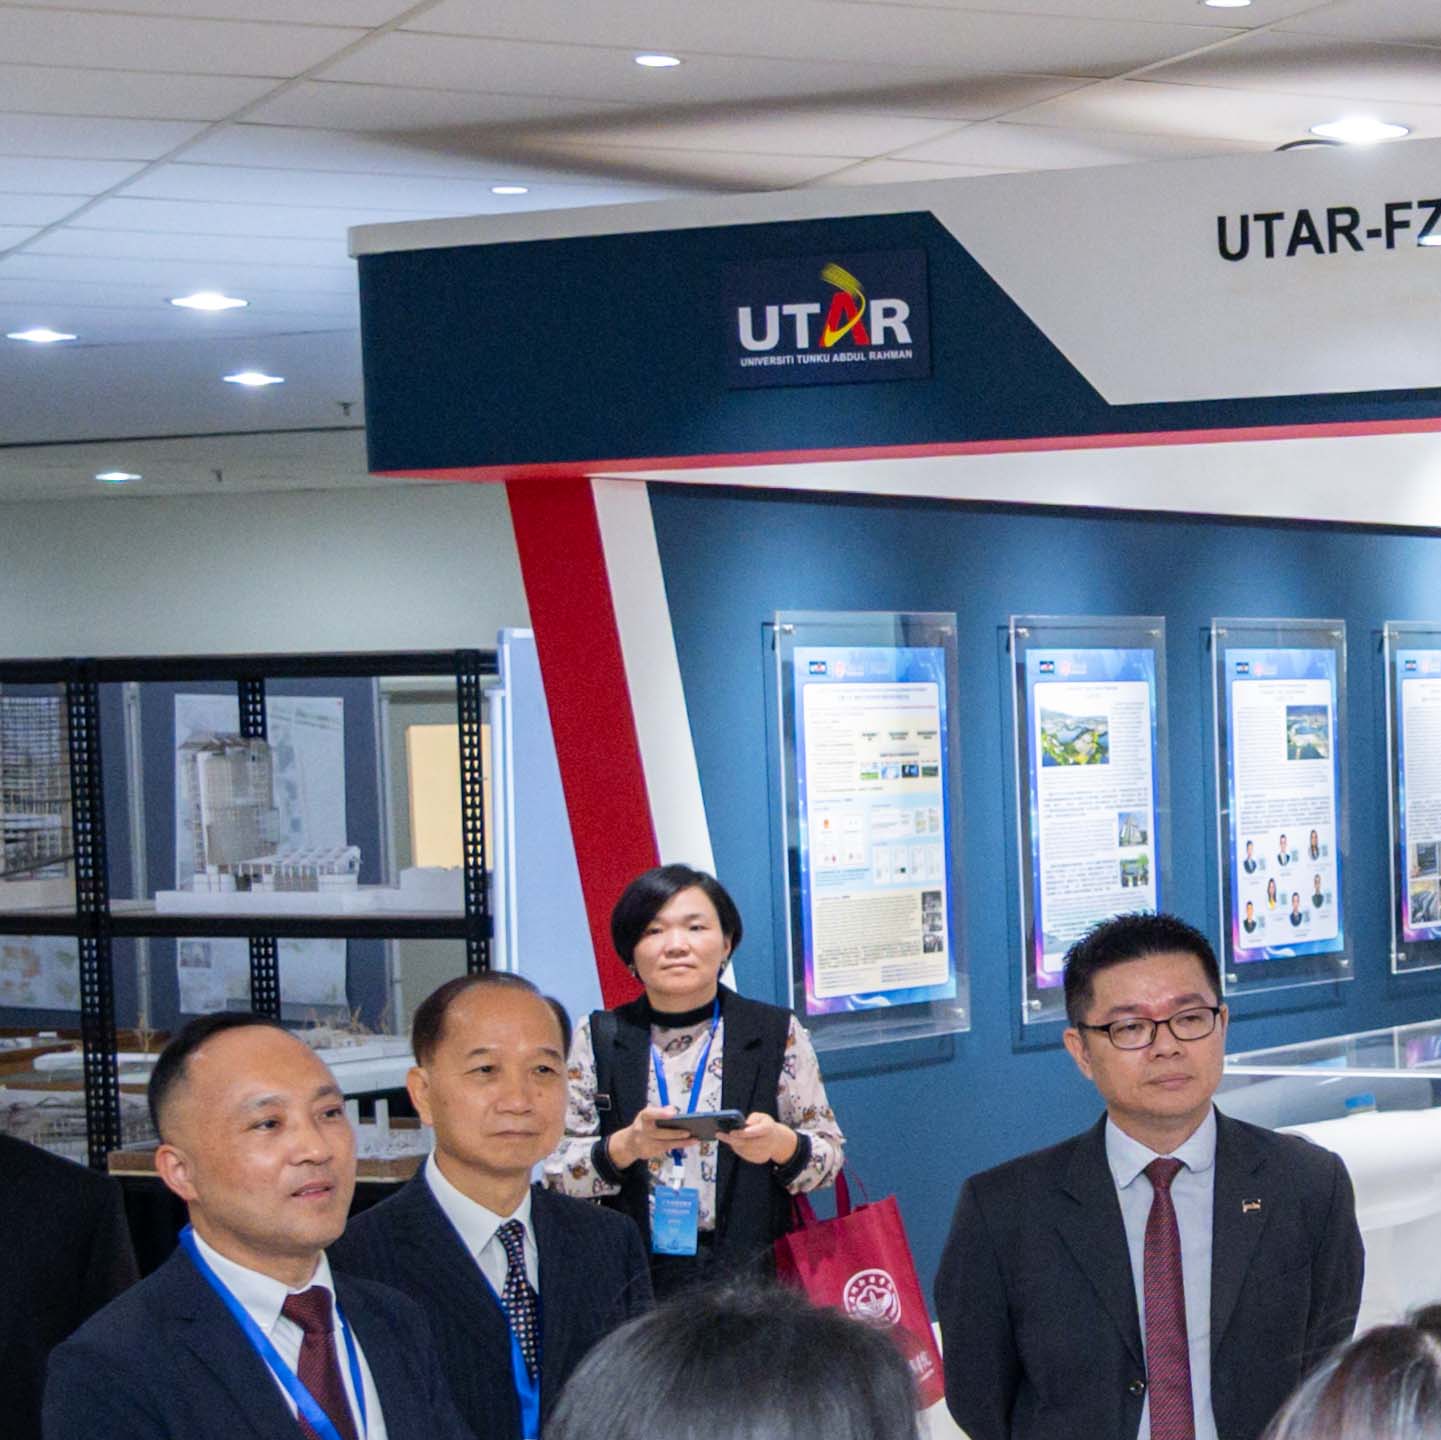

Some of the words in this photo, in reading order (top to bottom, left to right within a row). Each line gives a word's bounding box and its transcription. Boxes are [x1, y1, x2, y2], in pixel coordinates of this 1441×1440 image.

[738, 288, 912, 351] UTAR
[740, 354, 795, 367] UNIVERSITI
[797, 353, 830, 364] TUNKU
[832, 351, 866, 363] ABDUL
[869, 349, 913, 361] RAHMAN
